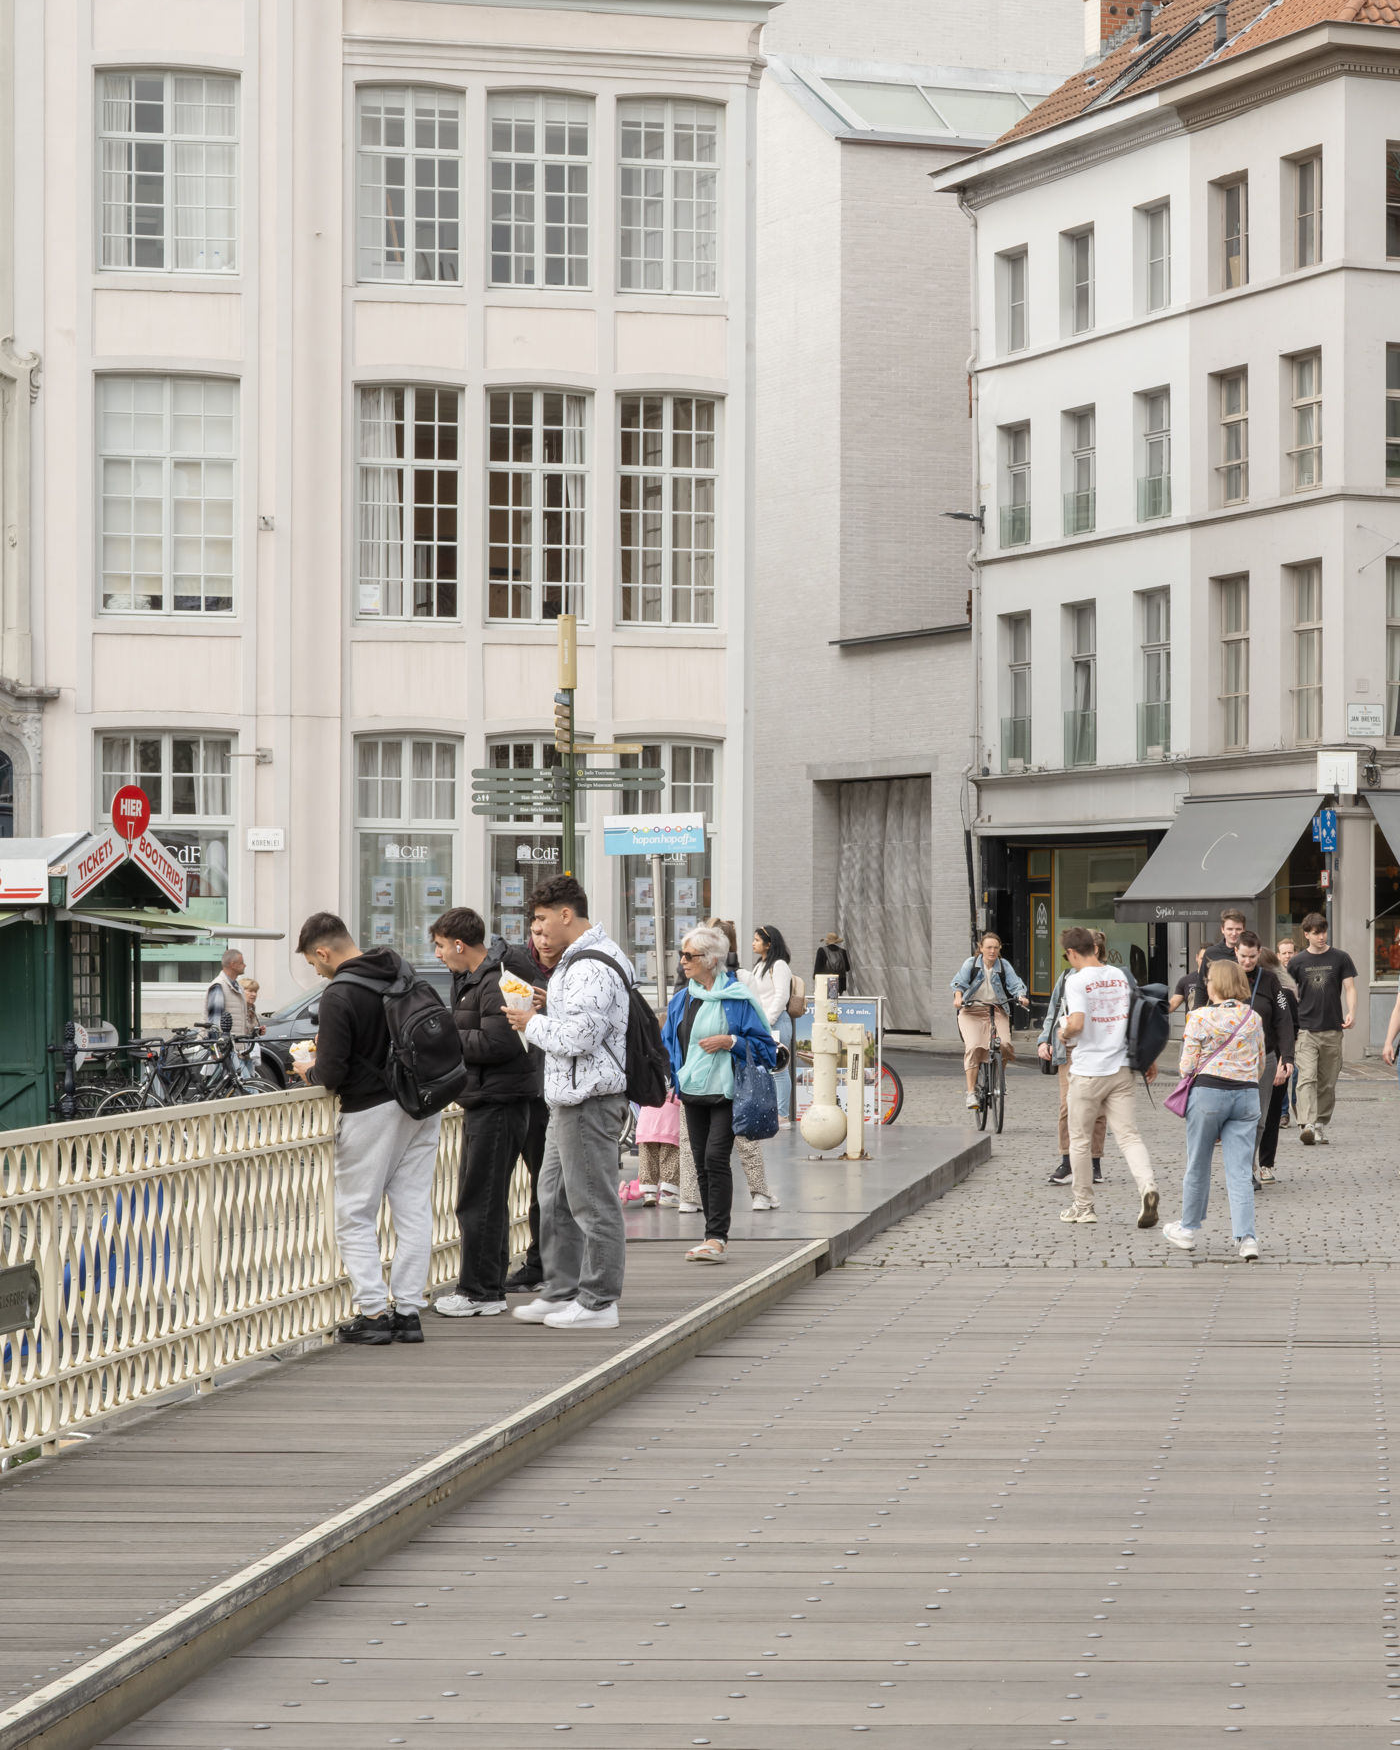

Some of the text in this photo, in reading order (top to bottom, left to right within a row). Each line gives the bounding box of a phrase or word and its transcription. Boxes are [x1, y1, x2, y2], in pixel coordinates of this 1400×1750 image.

[1360, 715, 1381, 723] BREYDEL
[120, 798, 143, 817] HIER
[251, 839, 280, 847] KORENLEI
[77, 837, 114, 881] TICKETS
[400, 846, 428, 859] CdF
[531, 847, 560, 860] CdF
[138, 835, 184, 892] BOOTTRIPS
[855, 1008, 872, 1016] min.
